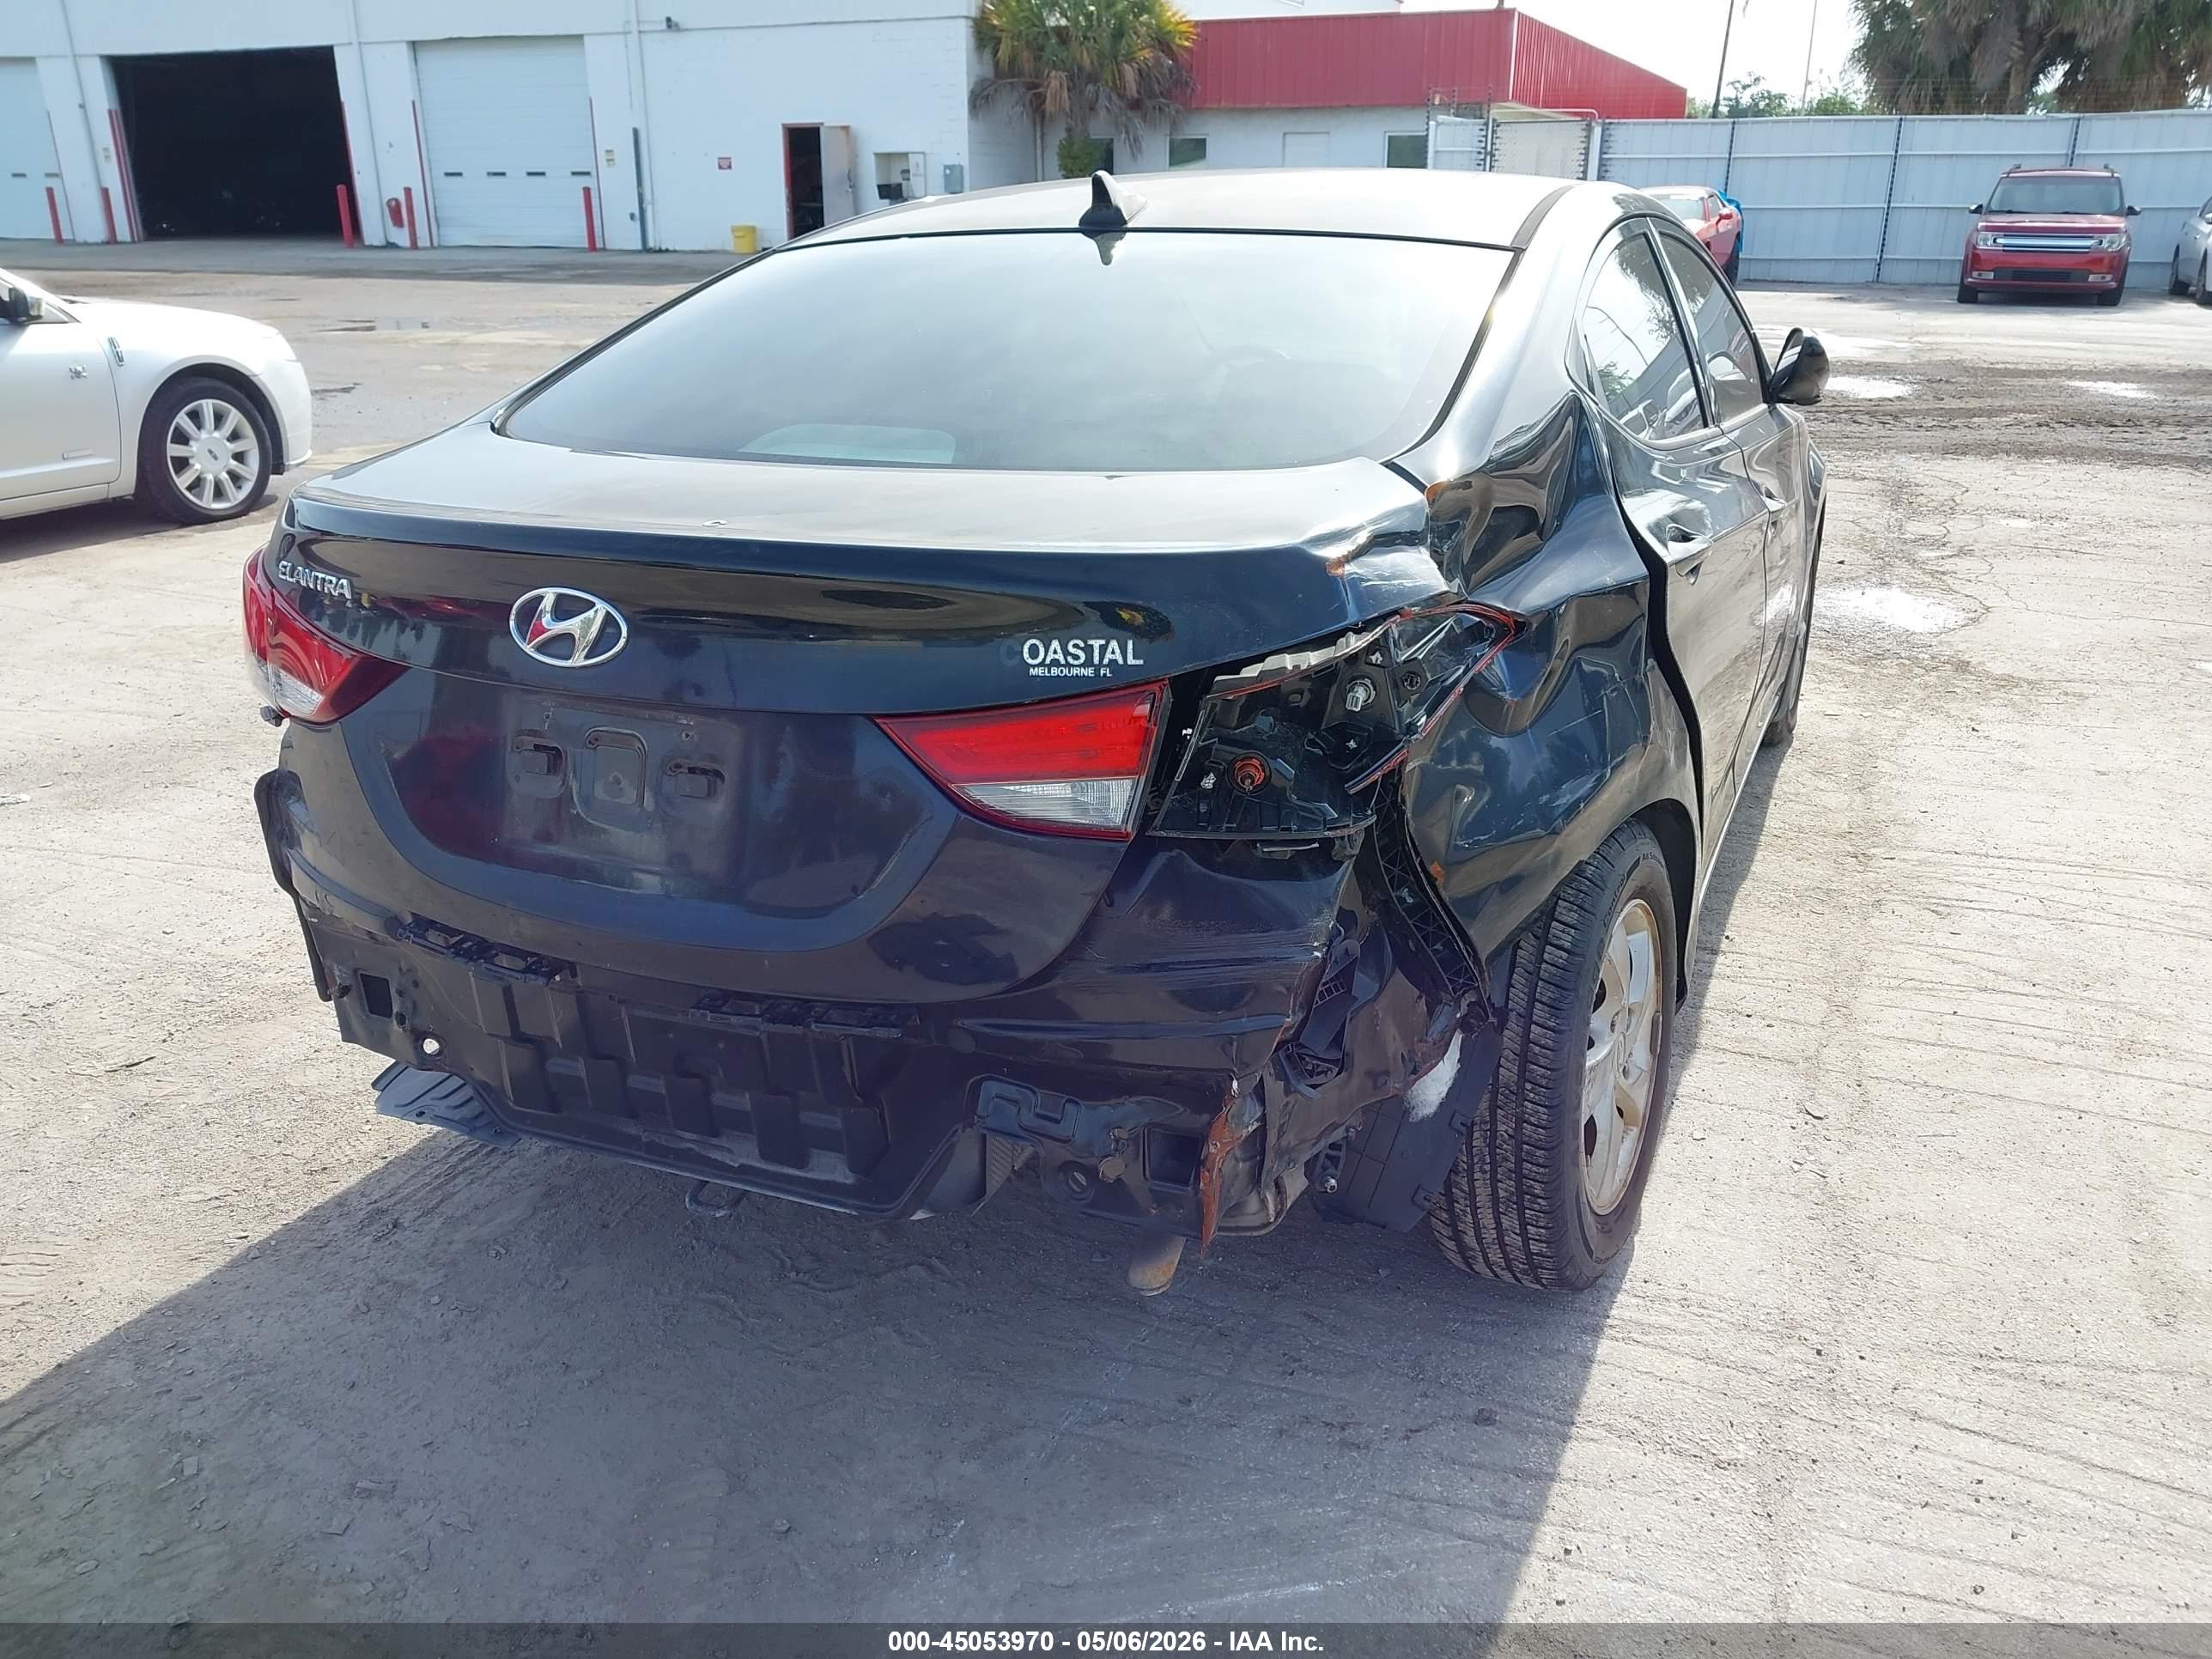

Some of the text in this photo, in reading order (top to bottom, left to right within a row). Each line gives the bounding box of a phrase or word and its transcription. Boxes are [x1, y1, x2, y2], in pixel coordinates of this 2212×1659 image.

[279, 560, 351, 599] ELANTRA
[1029, 666, 1112, 677] MELBOURNE FL
